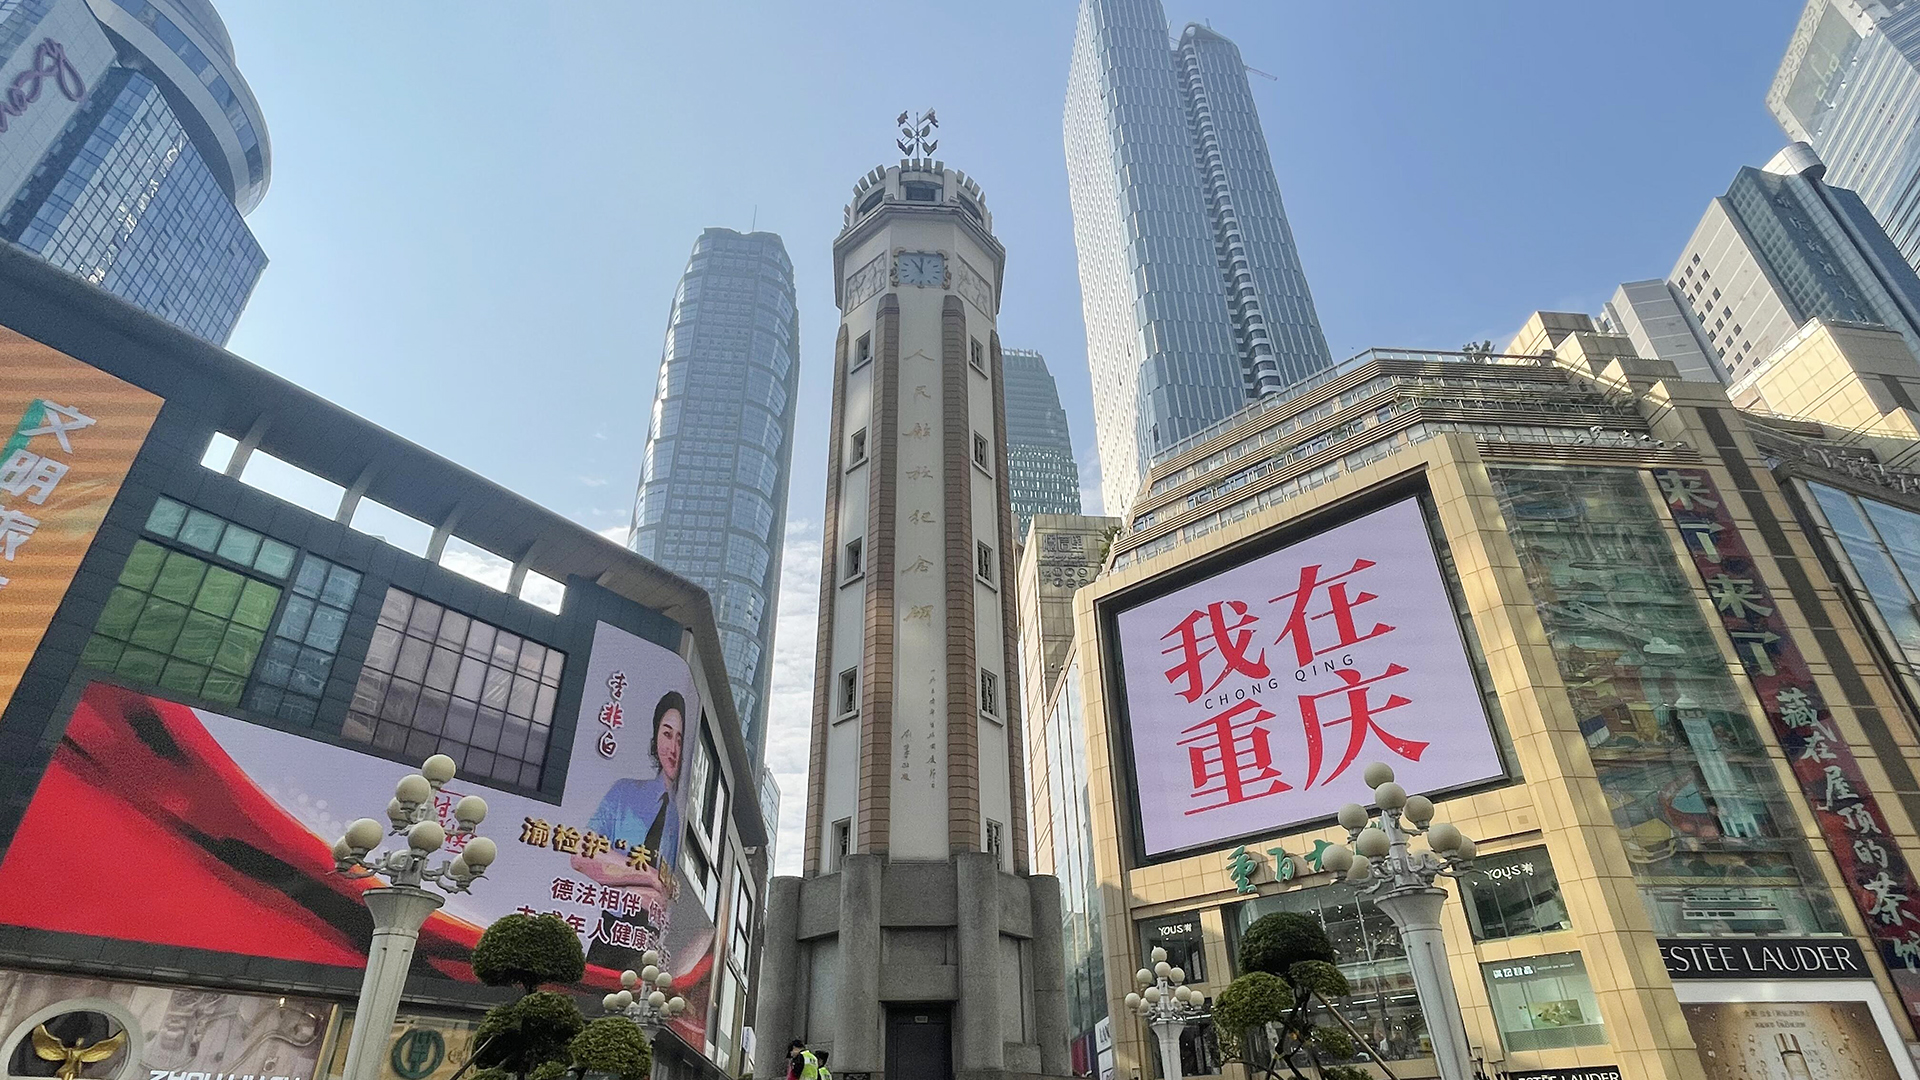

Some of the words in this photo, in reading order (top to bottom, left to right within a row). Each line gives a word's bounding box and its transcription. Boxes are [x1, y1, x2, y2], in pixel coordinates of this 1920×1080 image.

[0, 400, 97, 588] 文明旅
[1161, 558, 1396, 704] 我在
[1204, 678, 1279, 710] CHONG
[1295, 654, 1354, 682] QING
[1176, 663, 1430, 816] 重庆
[551, 877, 643, 917] 德法相伴
[1742, 946, 1858, 972] LAUDER
